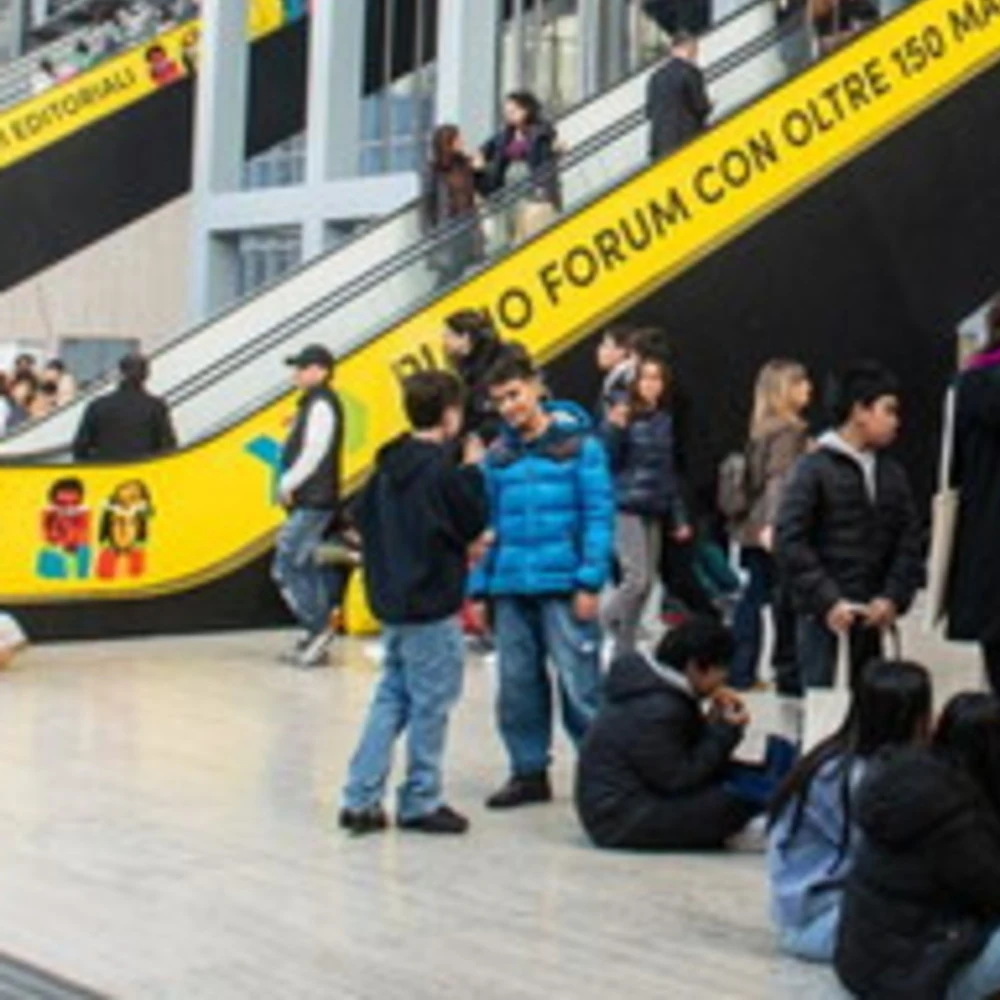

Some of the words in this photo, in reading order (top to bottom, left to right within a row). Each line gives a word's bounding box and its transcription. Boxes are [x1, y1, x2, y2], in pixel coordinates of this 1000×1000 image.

[10, 66, 137, 141] EDITORIALI
[391, 287, 533, 384] PIO
[538, 187, 691, 306] FORUM
[692, 130, 779, 205] CON
[781, 58, 891, 148] OLTRE
[891, 25, 946, 78] 150
